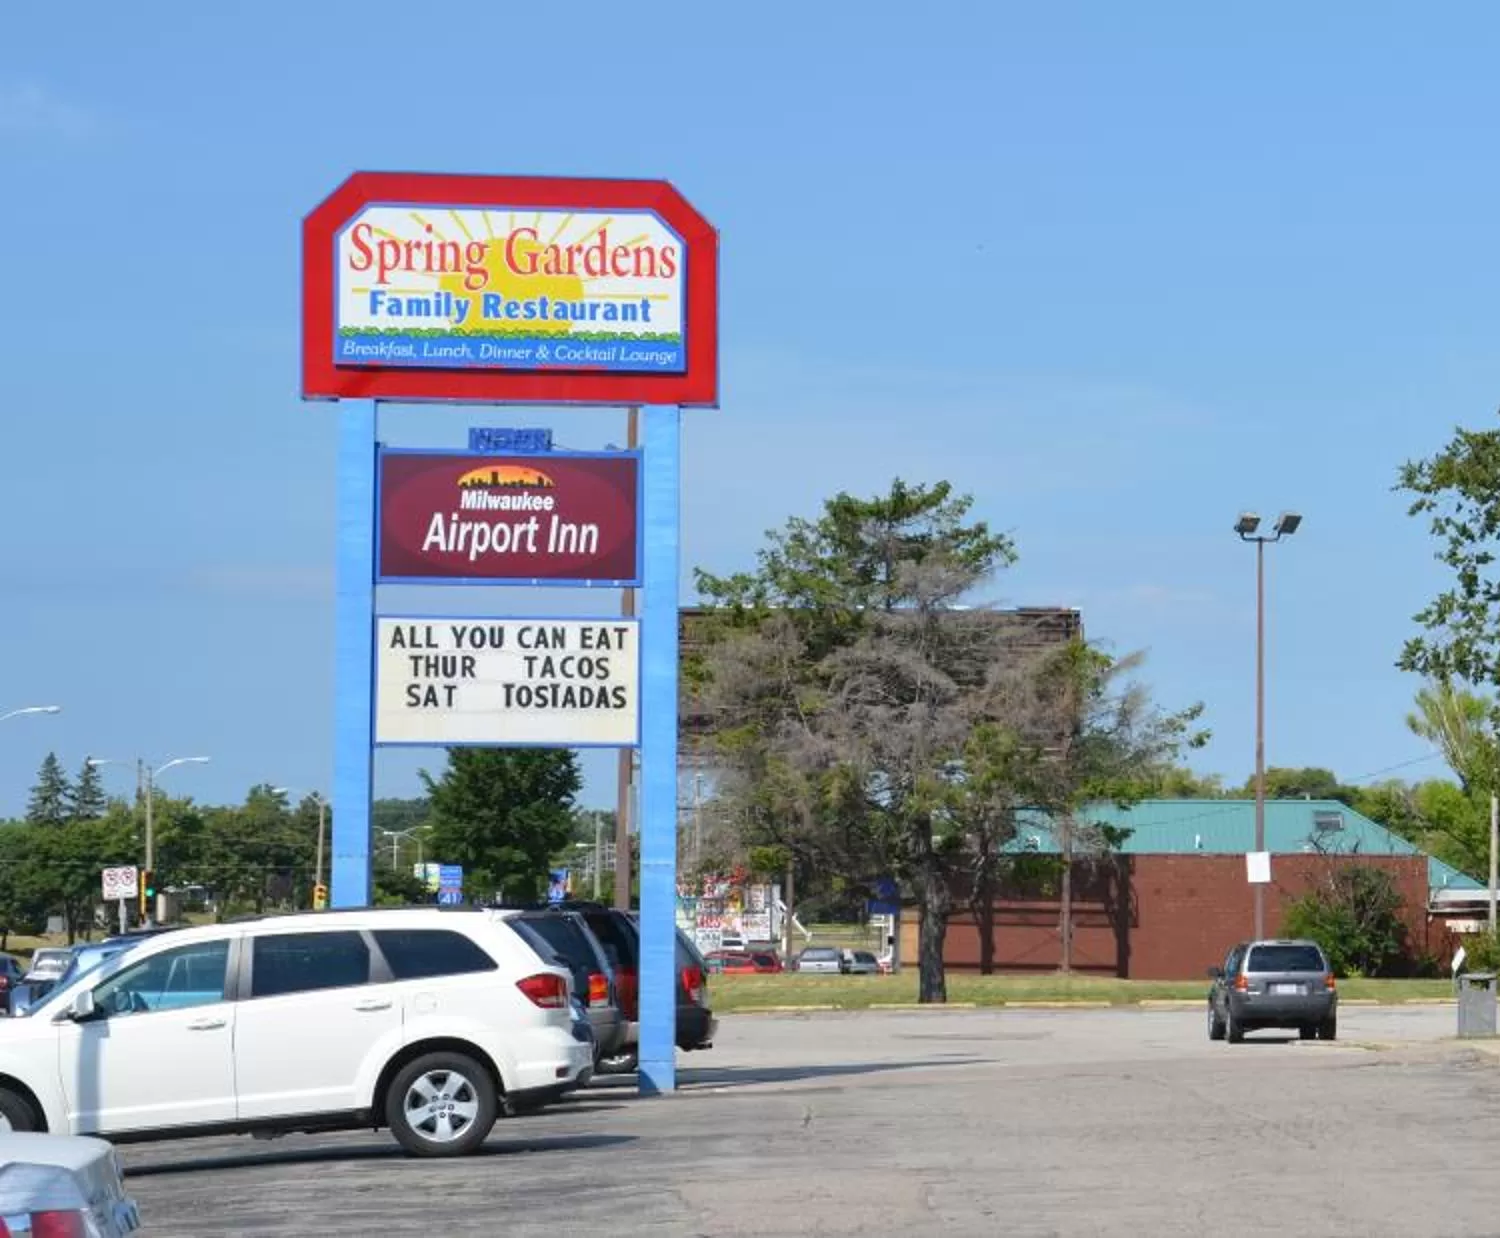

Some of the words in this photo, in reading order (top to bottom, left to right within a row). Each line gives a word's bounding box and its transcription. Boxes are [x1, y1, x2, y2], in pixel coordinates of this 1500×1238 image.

[349, 223, 489, 290] Spring
[505, 227, 676, 279] Gardens
[370, 290, 470, 324] Family
[483, 296, 651, 322] Restaurant
[343, 339, 416, 359] Breakfast,
[423, 342, 475, 359] Lunch,
[480, 343, 533, 360] Dinner
[535, 344, 550, 361] &
[555, 345, 616, 361] Cocktail
[619, 347, 677, 364] Lounge
[460, 490, 555, 511] Milwaukee
[421, 512, 539, 561] Airport
[548, 515, 599, 554] Inn
[390, 626, 439, 649] ALL
[452, 626, 504, 649] YOU
[517, 626, 565, 649] CAN
[580, 627, 629, 650] EAT
[409, 655, 476, 678] THUR
[523, 655, 610, 679] TACOS
[406, 684, 457, 707] SAT
[503, 684, 627, 708] TOSTADAS
